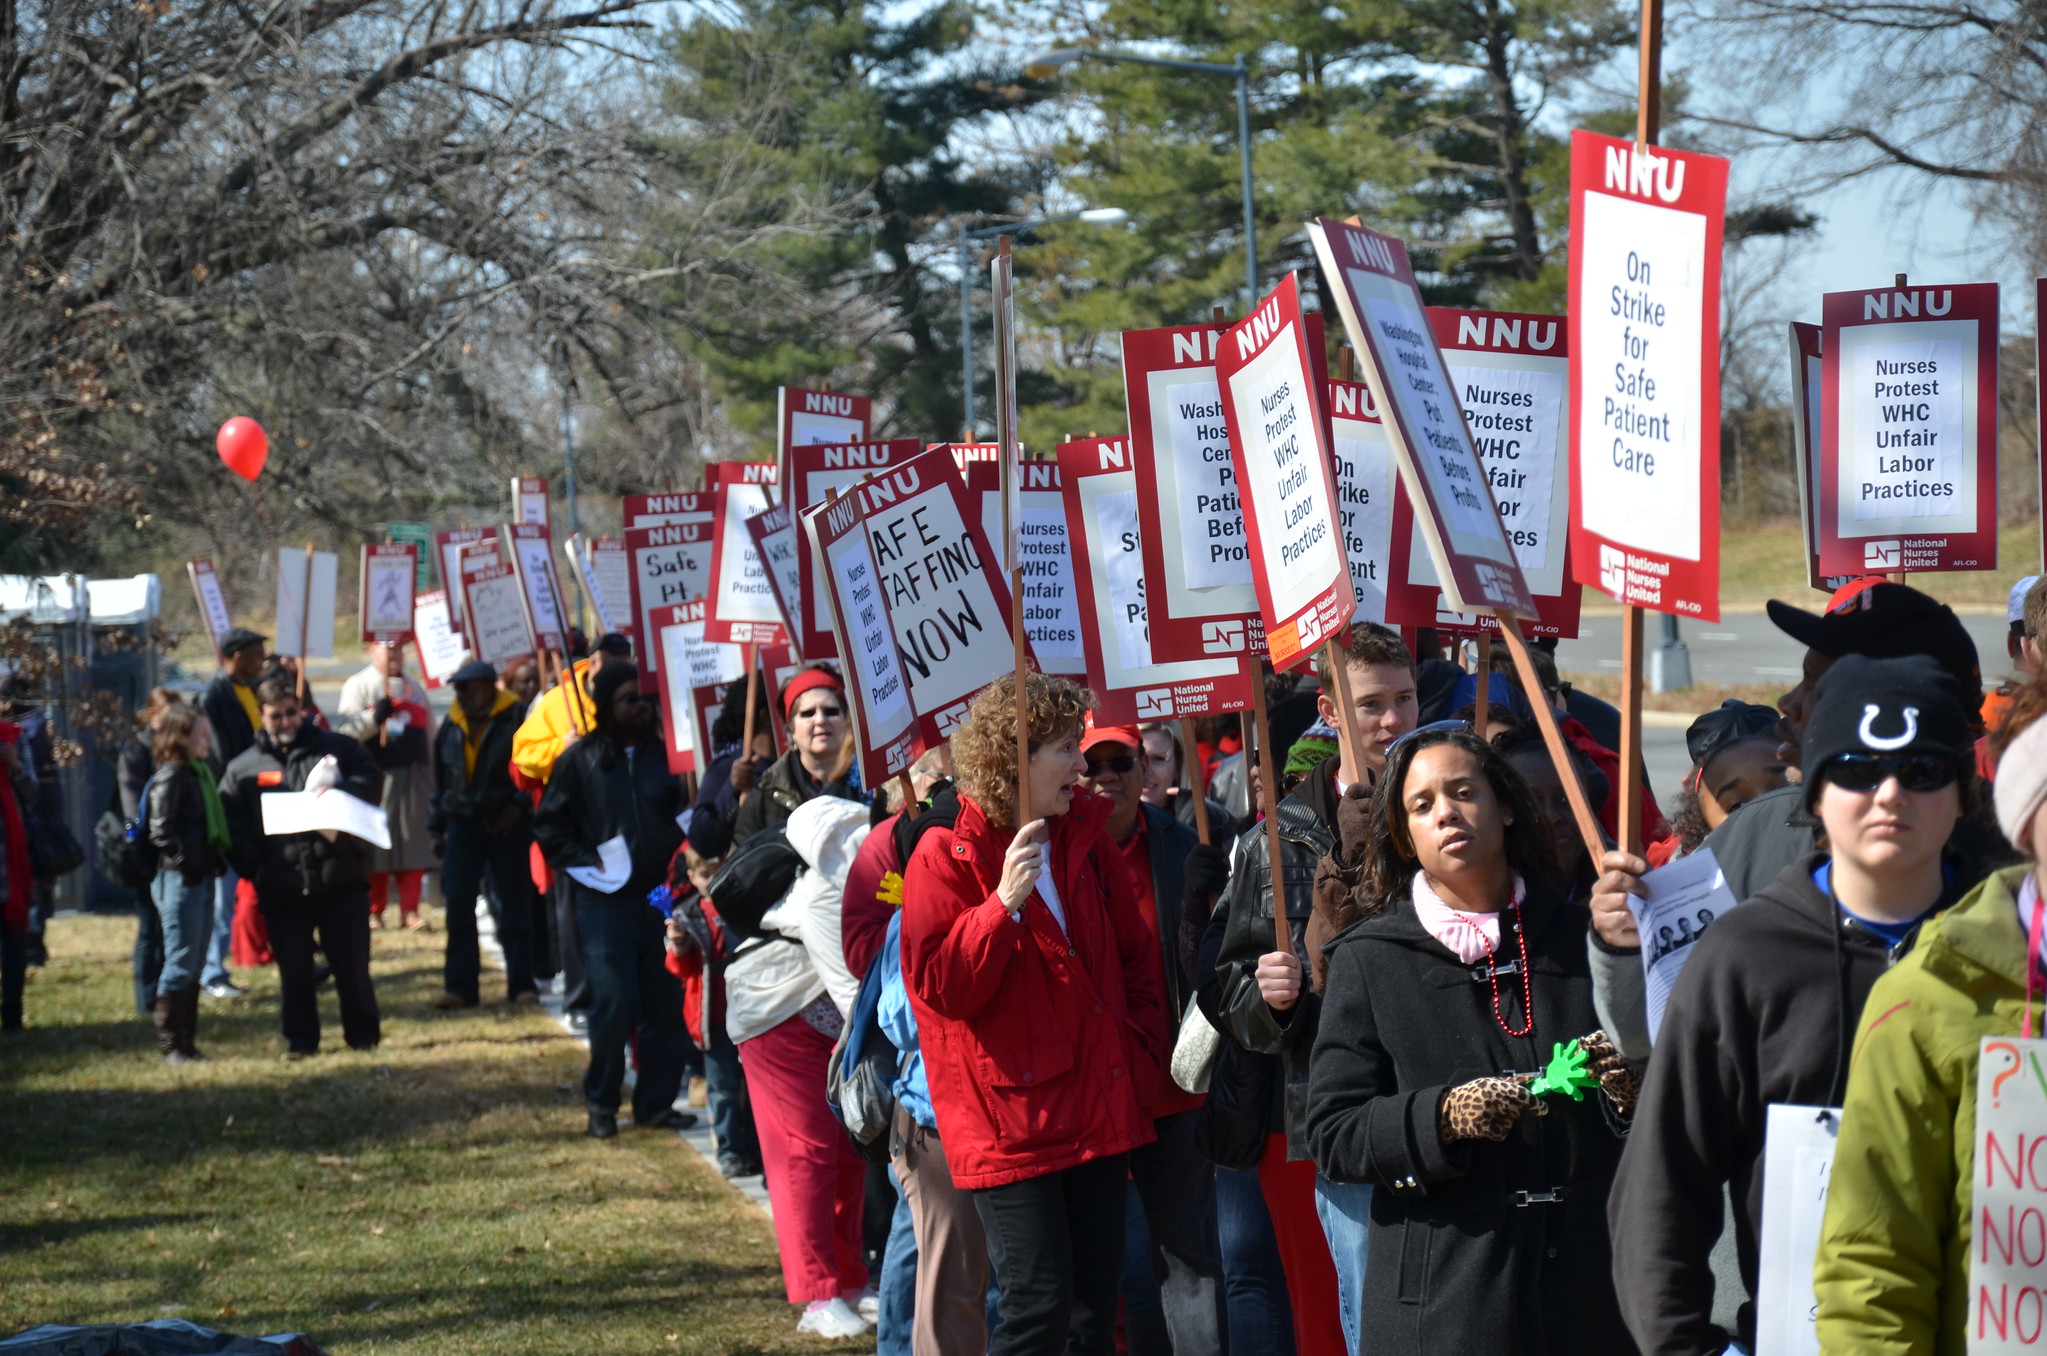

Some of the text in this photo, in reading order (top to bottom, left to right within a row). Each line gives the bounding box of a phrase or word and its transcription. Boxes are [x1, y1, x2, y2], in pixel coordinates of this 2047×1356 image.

[1605, 145, 1686, 203] NNU
[1344, 229, 1395, 274] NNU
[1627, 251, 1650, 285] On
[1611, 285, 1665, 327] Strike
[1864, 291, 1952, 320] NNU
[1235, 296, 1280, 361] NNU
[1458, 315, 1556, 350] NNU
[1624, 326, 1649, 361] for
[1876, 359, 1937, 376] Nurses
[1616, 363, 1655, 401] Safe
[1875, 379, 1939, 398] Protest
[806, 393, 852, 416] NNU
[1260, 380, 1290, 417] Nurses
[1466, 384, 1532, 407] Nurses
[1424, 399, 1444, 423] Put
[1464, 410, 1533, 432] Protest
[1604, 397, 1670, 442] Patient
[1882, 403, 1930, 423] WHC
[1265, 406, 1297, 443] Protest
[1424, 427, 1463, 454] Patients
[1876, 429, 1938, 448] Unfair
[824, 444, 889, 468] NNU
[1274, 434, 1299, 470] WHC
[1613, 438, 1655, 476] Care
[1440, 455, 1471, 481] Before
[1879, 455, 1935, 473] Labor
[858, 466, 920, 513] NU
[1278, 464, 1308, 501] Unfair
[1488, 467, 1526, 489] fair
[1338, 482, 1369, 504] rike
[1451, 484, 1482, 511] Profits
[1862, 480, 1953, 500] Practices
[647, 494, 697, 513] NNU
[1284, 494, 1313, 530] Labor
[826, 496, 854, 536] NNU
[1340, 510, 1355, 527] or
[648, 525, 698, 545] NNU
[873, 505, 940, 566] AFE
[1282, 518, 1326, 567] Practices
[1904, 539, 1947, 548] National
[1020, 540, 1065, 555] rotest
[1904, 549, 1939, 557] Nurses
[646, 550, 697, 576] Safe
[847, 561, 865, 584] Nurses
[881, 532, 985, 610] TAFFING
[1022, 561, 1058, 576] WHC
[1627, 554, 1669, 576] National
[1904, 558, 1938, 567] United
[732, 581, 772, 594] Practic
[1627, 568, 1661, 588] Nurses
[661, 581, 686, 602] Pt
[852, 582, 872, 606] Protest
[1317, 587, 1337, 611] National
[1626, 584, 1661, 604] United
[860, 603, 876, 628] WHC
[1021, 604, 1061, 620] abor
[1319, 604, 1338, 626] Nurses
[1321, 613, 1340, 634] United
[865, 628, 883, 653] Unfair
[899, 589, 983, 687] NOW
[1028, 627, 1075, 641] ctices
[1533, 625, 1559, 633] AFL-CIO
[685, 645, 720, 659] Protest
[690, 658, 716, 672] WHC
[872, 654, 889, 677] Labor
[872, 674, 899, 705] Practices
[1174, 682, 1214, 695] National
[1176, 693, 1208, 704] Nurses
[1176, 703, 1208, 714] United
[1222, 701, 1244, 709] AFL-CIO
